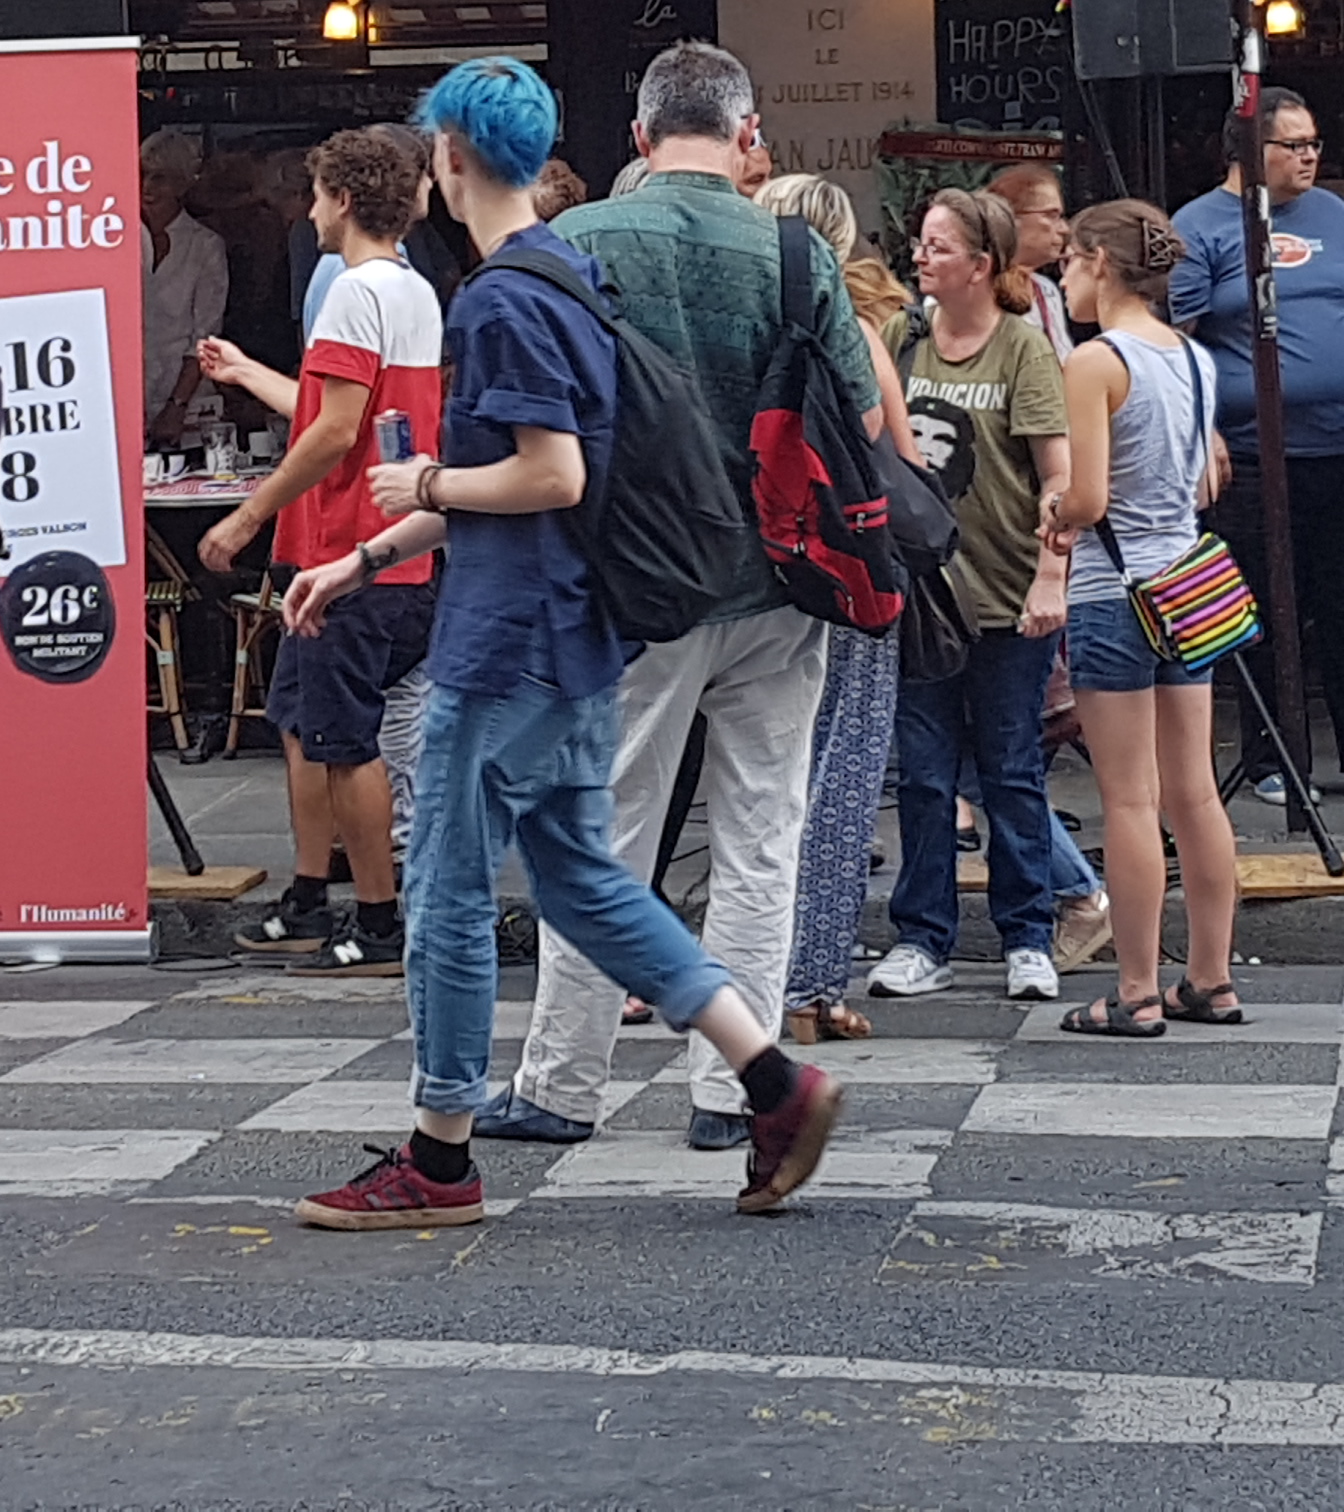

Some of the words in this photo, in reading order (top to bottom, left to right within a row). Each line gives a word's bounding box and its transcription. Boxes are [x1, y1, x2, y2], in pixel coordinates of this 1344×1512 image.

[807, 8, 844, 31] ICI
[815, 48, 839, 65] LE
[948, 17, 1062, 64] HAPPY
[772, 82, 863, 104] JUILLET
[872, 81, 915, 101] 1914
[949, 66, 1063, 103] HOURS
[26, 139, 92, 194] de
[769, 140, 804, 171] AN
[4, 336, 76, 393] 16
[21, 584, 99, 627] 26€
